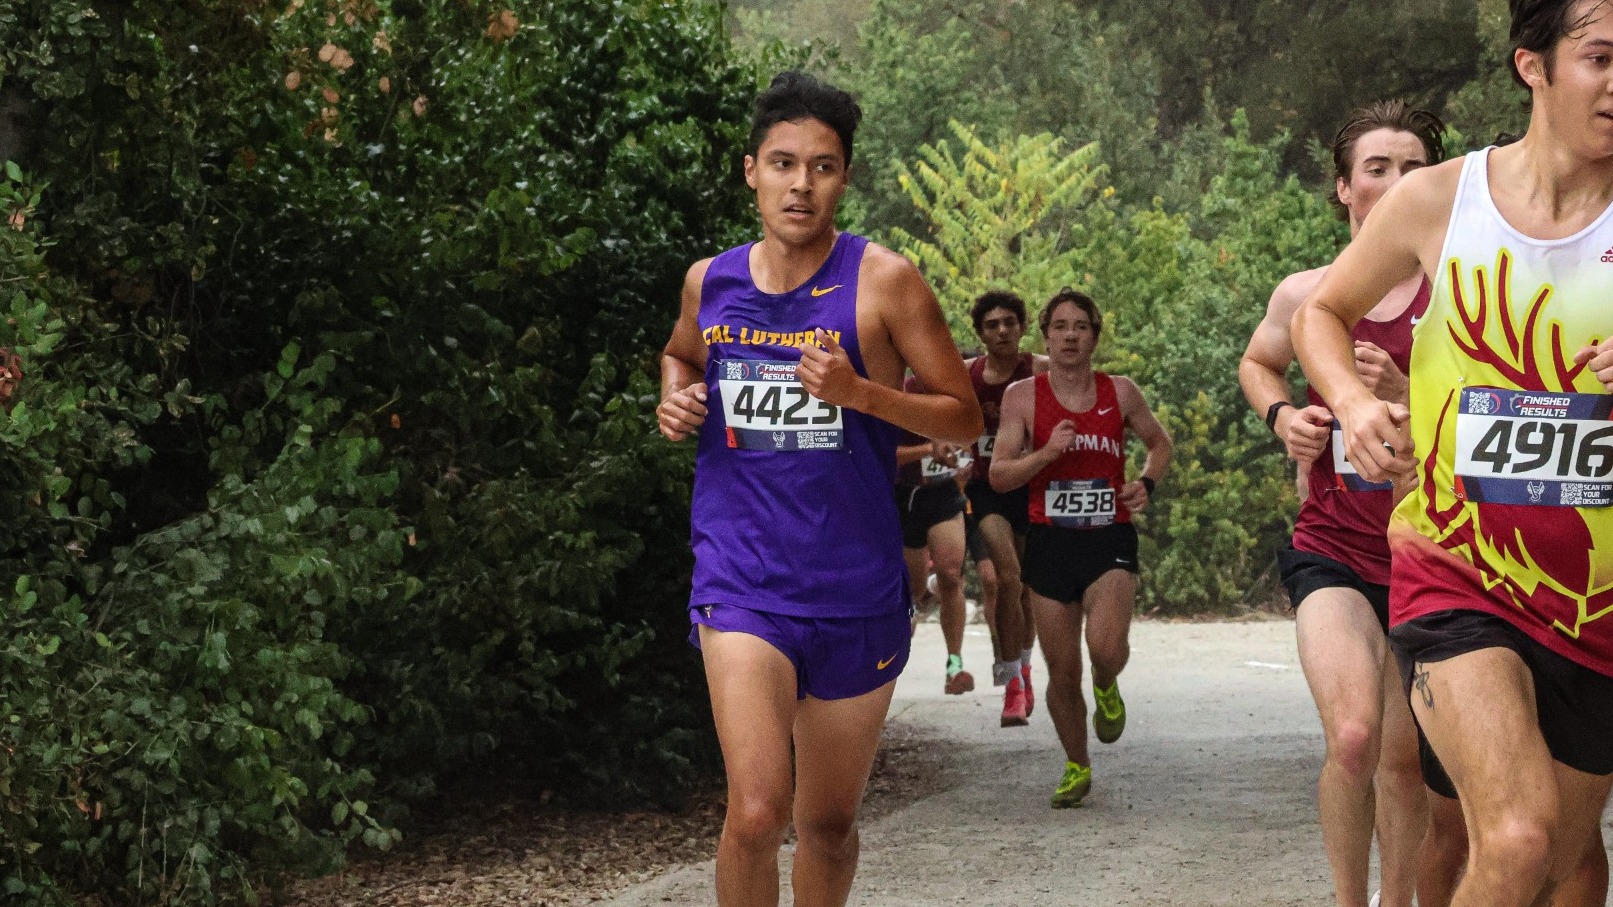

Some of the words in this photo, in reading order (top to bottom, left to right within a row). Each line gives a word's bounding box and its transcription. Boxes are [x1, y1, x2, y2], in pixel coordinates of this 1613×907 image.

[703, 325, 734, 346] CAL
[764, 364, 797, 372] FINISHED
[762, 373, 795, 381] RESULTS
[733, 385, 838, 425] 4423
[1522, 395, 1571, 406] FINISHED
[1520, 407, 1568, 418] RESULTS
[1471, 419, 1613, 478] 4916
[1052, 491, 1115, 514] 4538
